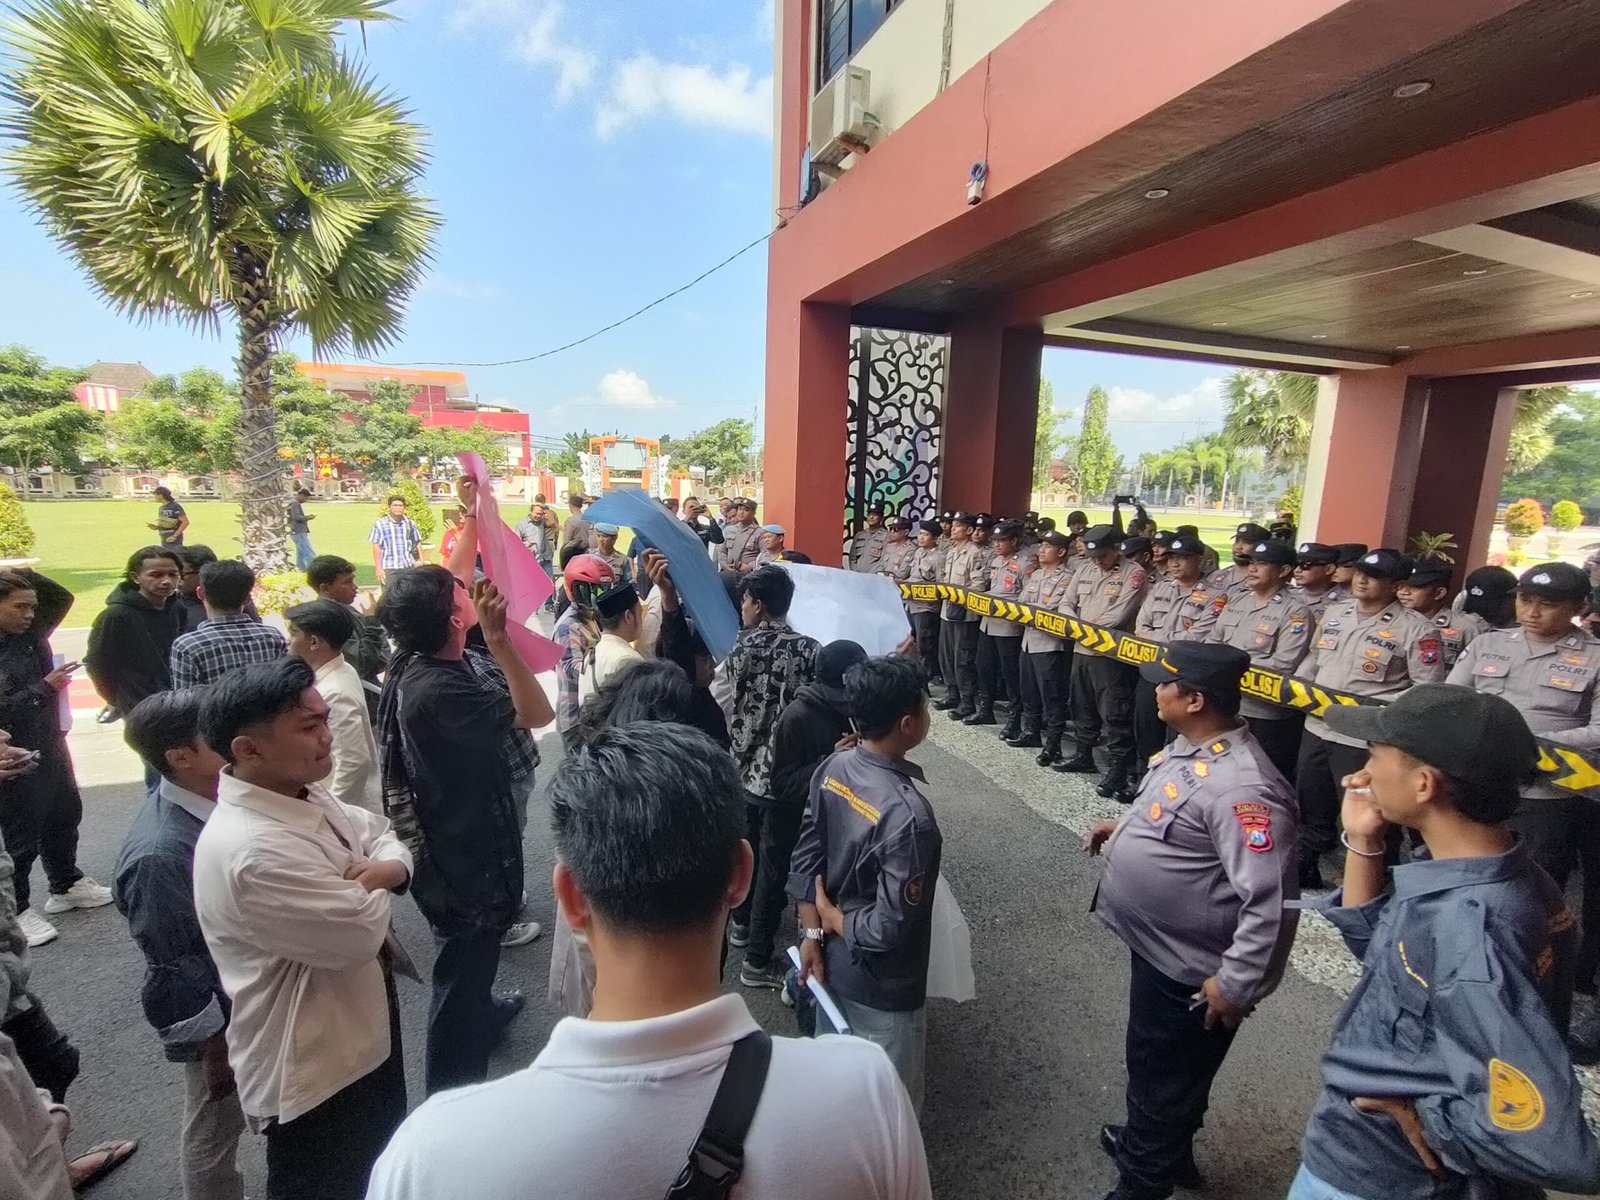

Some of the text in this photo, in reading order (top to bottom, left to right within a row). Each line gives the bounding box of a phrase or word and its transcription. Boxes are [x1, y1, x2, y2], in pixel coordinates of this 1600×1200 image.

[912, 586, 936, 599] POLISI
[1037, 614, 1064, 633] POLISI
[1261, 614, 1280, 623] POLRI
[1365, 635, 1397, 651] POLRI
[1549, 663, 1589, 676] POLRI
[1240, 671, 1279, 698] OLISI
[1178, 766, 1197, 789] POLRI
